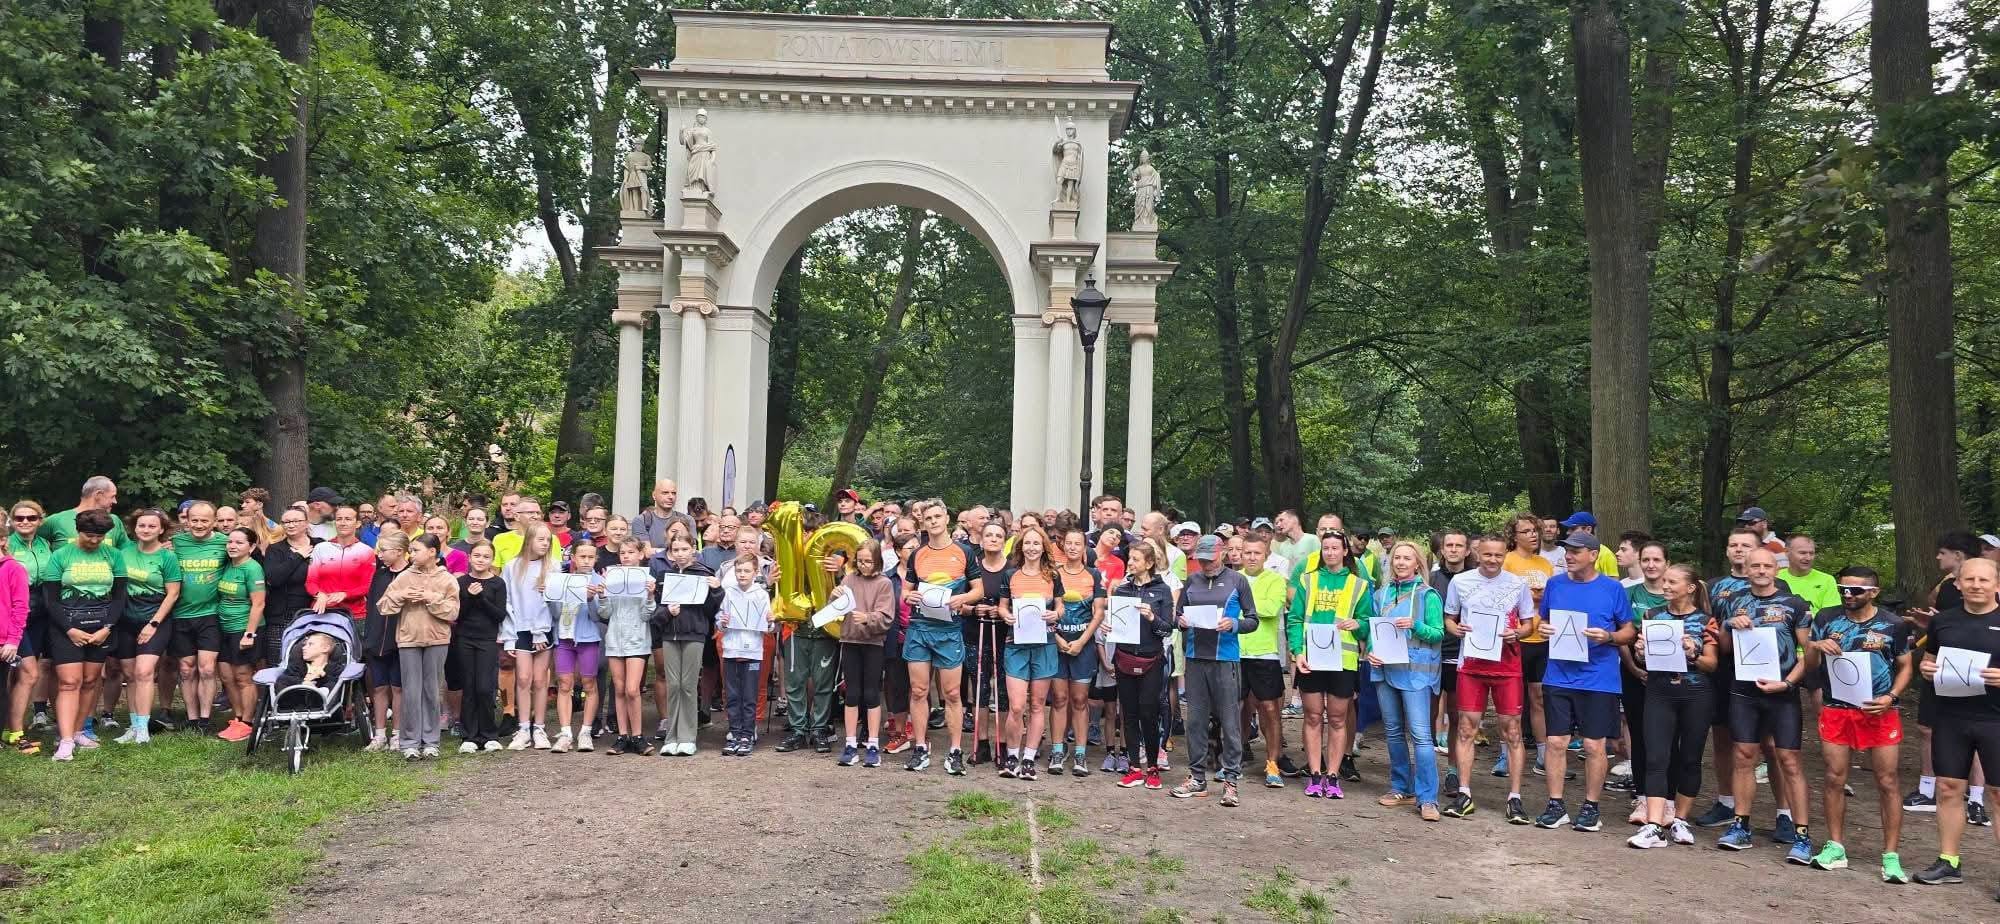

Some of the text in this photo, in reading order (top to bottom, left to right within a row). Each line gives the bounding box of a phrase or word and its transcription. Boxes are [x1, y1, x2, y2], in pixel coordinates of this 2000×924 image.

[777, 35, 1005, 64] PONIATOWSKIEMU
[1552, 614, 1584, 653] A
[1646, 623, 1677, 656] B
[1940, 656, 1974, 687] N
